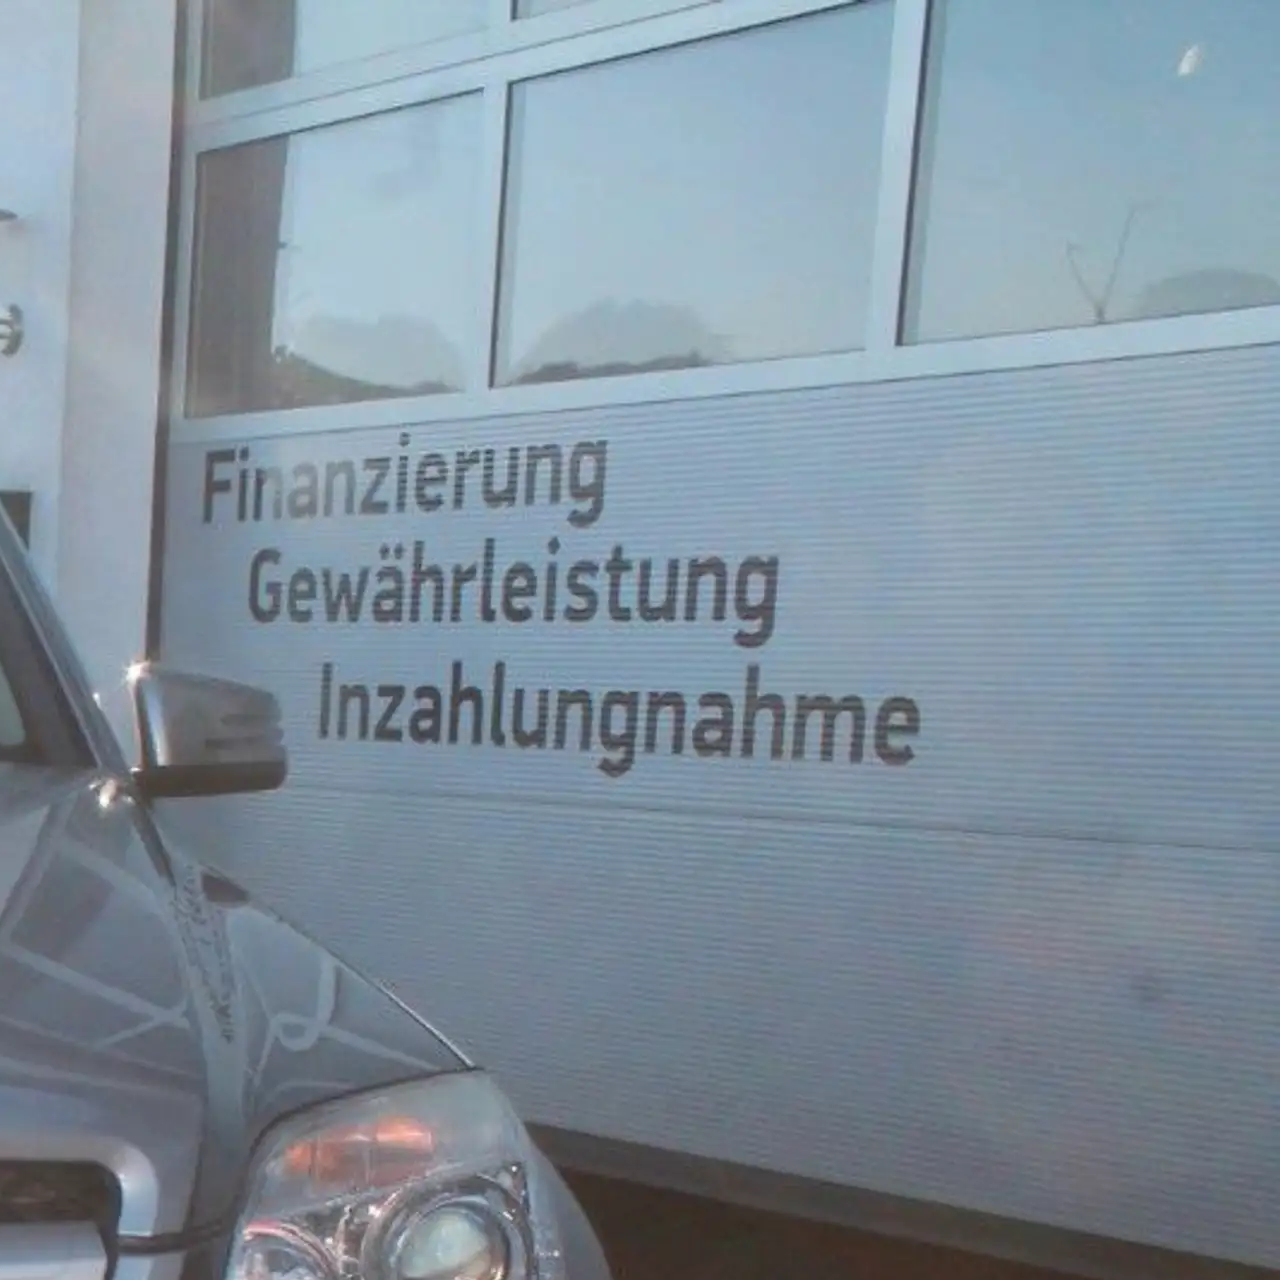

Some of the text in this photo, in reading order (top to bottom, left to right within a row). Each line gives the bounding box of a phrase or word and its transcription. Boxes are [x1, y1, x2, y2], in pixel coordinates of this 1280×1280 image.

[202, 431, 608, 527] Finanzierung
[248, 536, 779, 648] Gewährleistung
[317, 660, 921, 779] Inzahlungnahme
